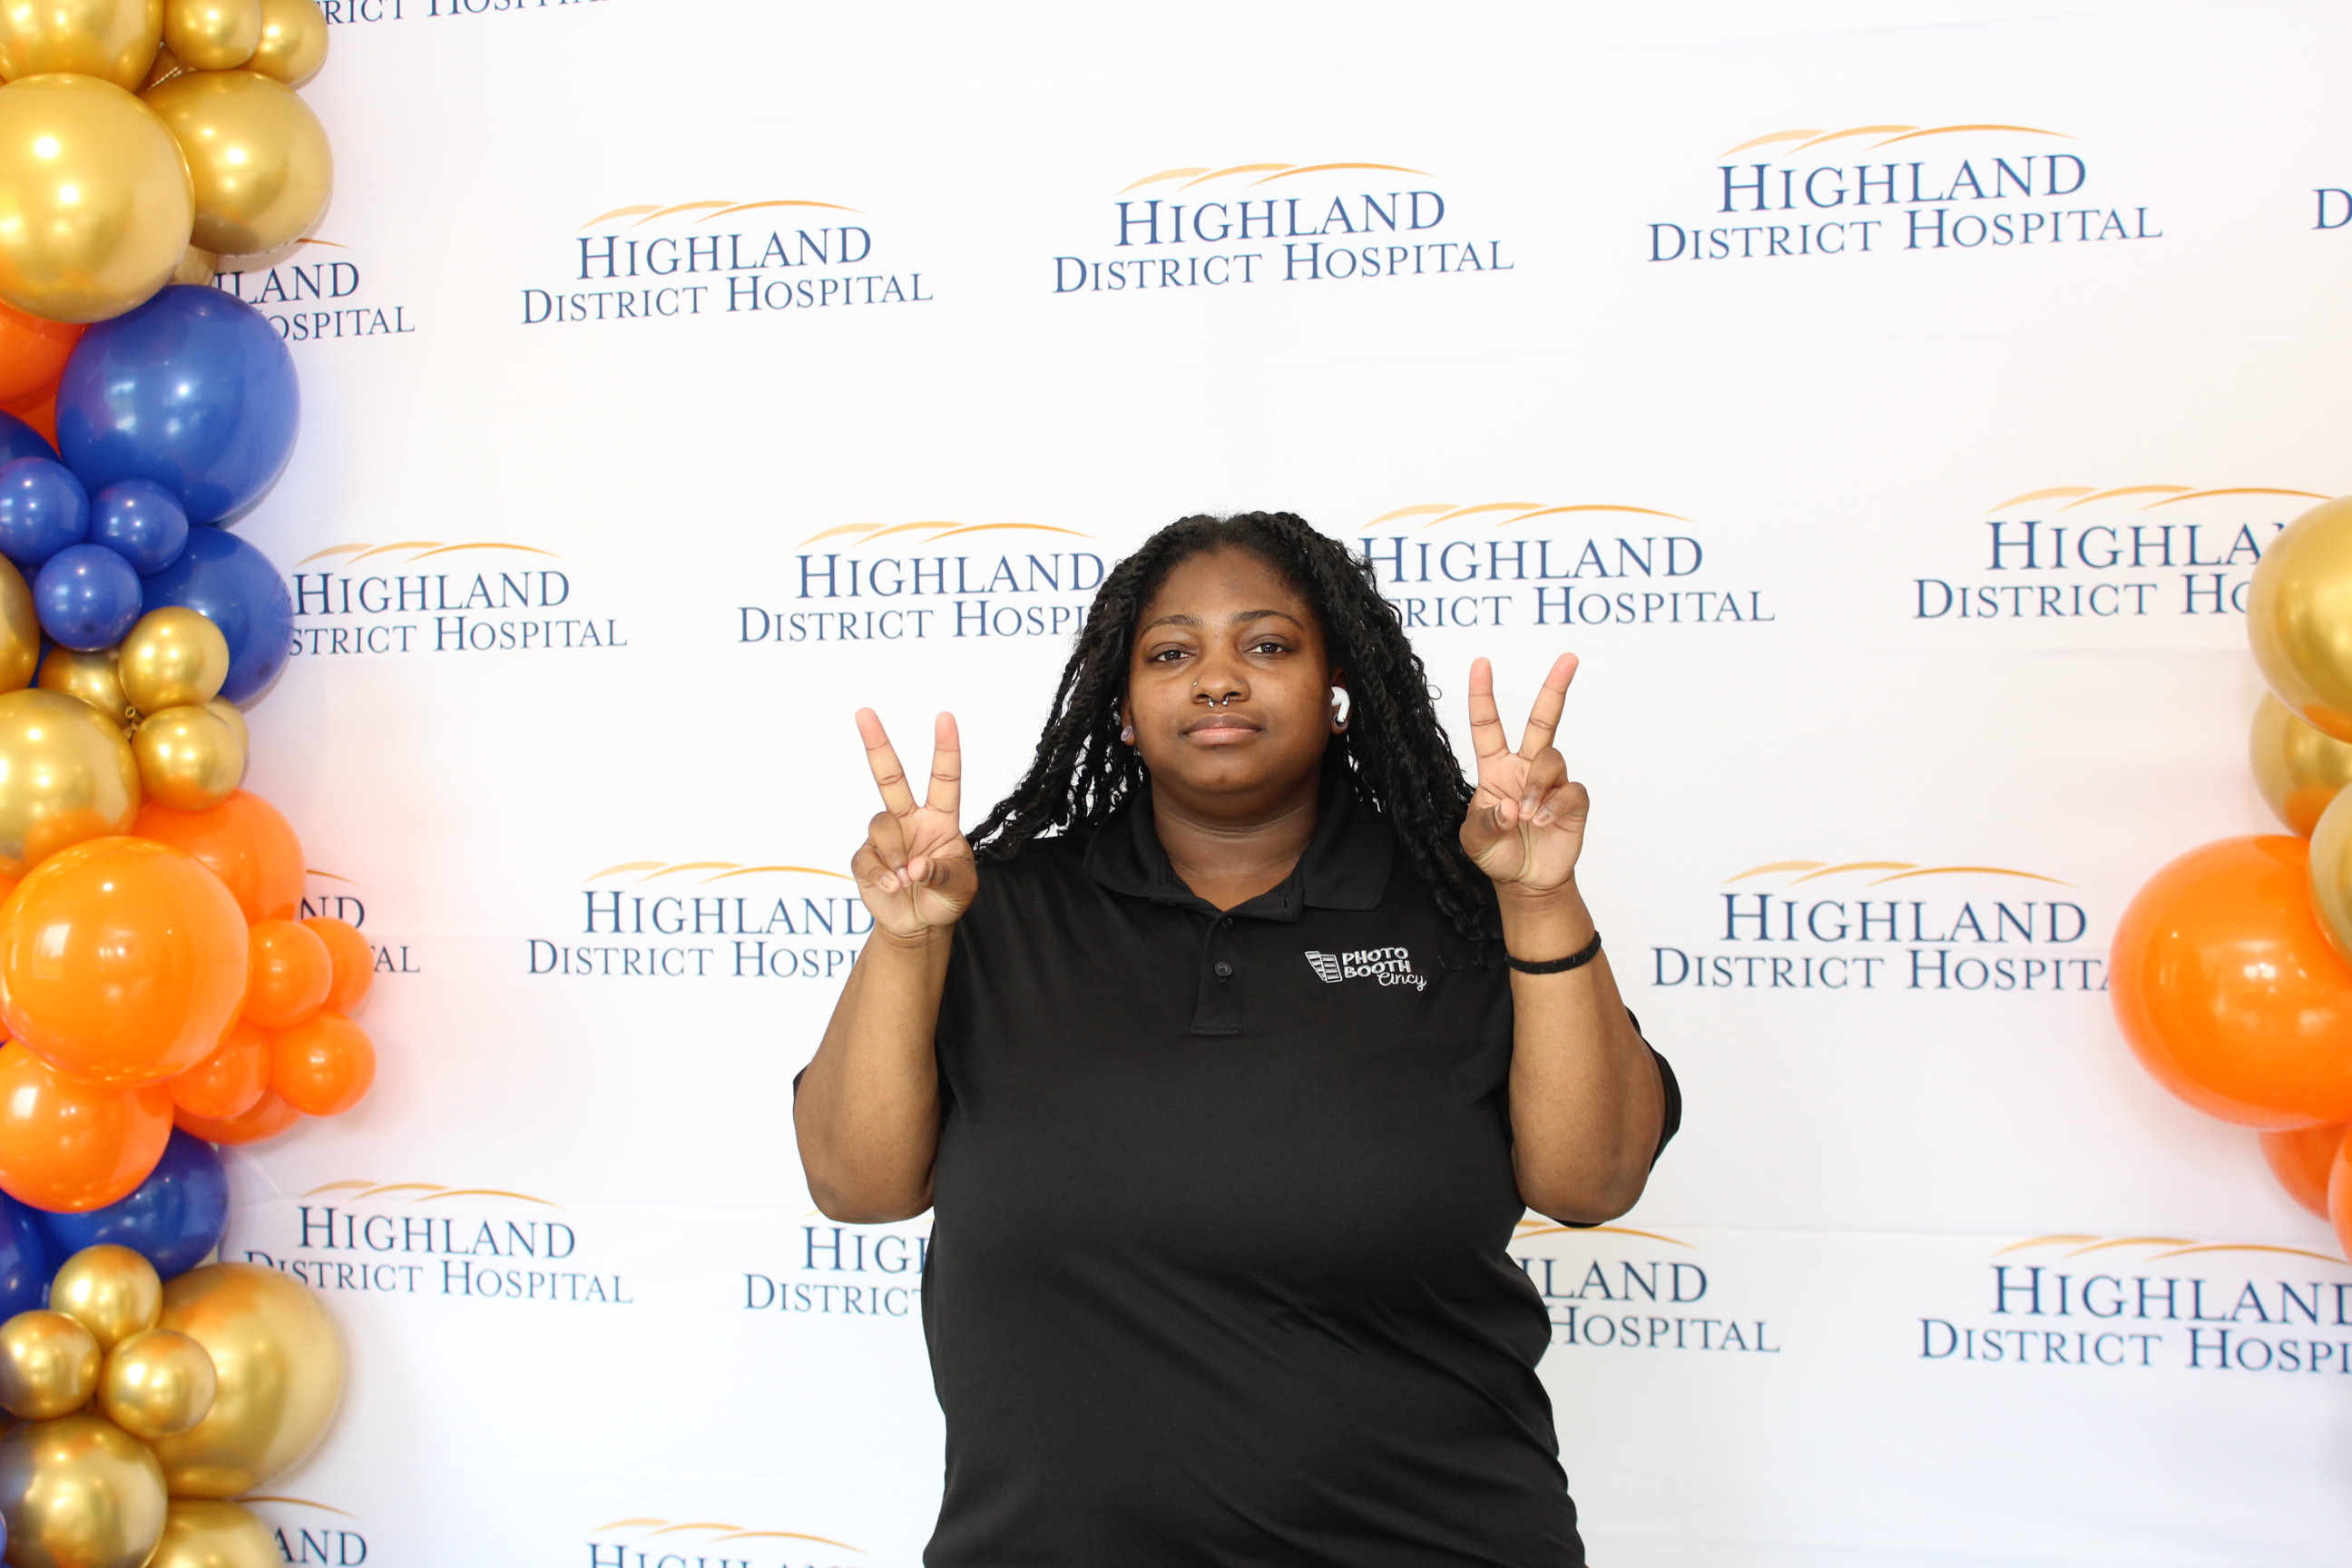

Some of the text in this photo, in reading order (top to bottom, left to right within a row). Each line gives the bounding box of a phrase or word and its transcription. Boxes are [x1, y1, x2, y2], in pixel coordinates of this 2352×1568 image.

[315, 0, 404, 24] RICT
[1717, 152, 2087, 213] HIGHLAND
[1114, 190, 1446, 247] HIGHLAND
[1647, 206, 2164, 263] DISTRICT HOSPITAL
[575, 226, 872, 280] HIGHLAND
[1052, 240, 1514, 294] DISTRICT HOSPITAL
[214, 261, 360, 306] LAND
[521, 273, 934, 325] DISTRICT HOSPITAL
[259, 306, 416, 342] OSPITAL
[1357, 535, 1703, 583] HIGHLAND
[1984, 520, 2286, 571] HIGHLA
[292, 571, 570, 616] HIGHLAND
[795, 552, 1105, 600] HIGHLAND
[1911, 578, 2158, 620] DISTRICT
[737, 600, 1086, 643] DISTRICT HOSPI
[1386, 585, 1776, 629] RICT HOSPITAL
[288, 615, 628, 657] STRICT HOSPITAL
[581, 890, 876, 936] HIGHLAND
[1720, 893, 2088, 944] HIGHLAND
[525, 938, 859, 979] DISTRICT HOSPI
[1341, 946, 1409, 966] PHOTO
[1343, 959, 1412, 979] BOOTH
[1650, 946, 2110, 992] DISTRICT HOSPIT
[1376, 972, 1427, 992] Cincy
[297, 1205, 576, 1259] HIGHLAND
[440, 1259, 633, 1304] HOSPITAL
[1515, 1257, 1709, 1303] LAND
[1544, 1303, 1781, 1354] HOSPITAL
[1917, 1318, 2352, 1374] DISTRICT HOSPI
